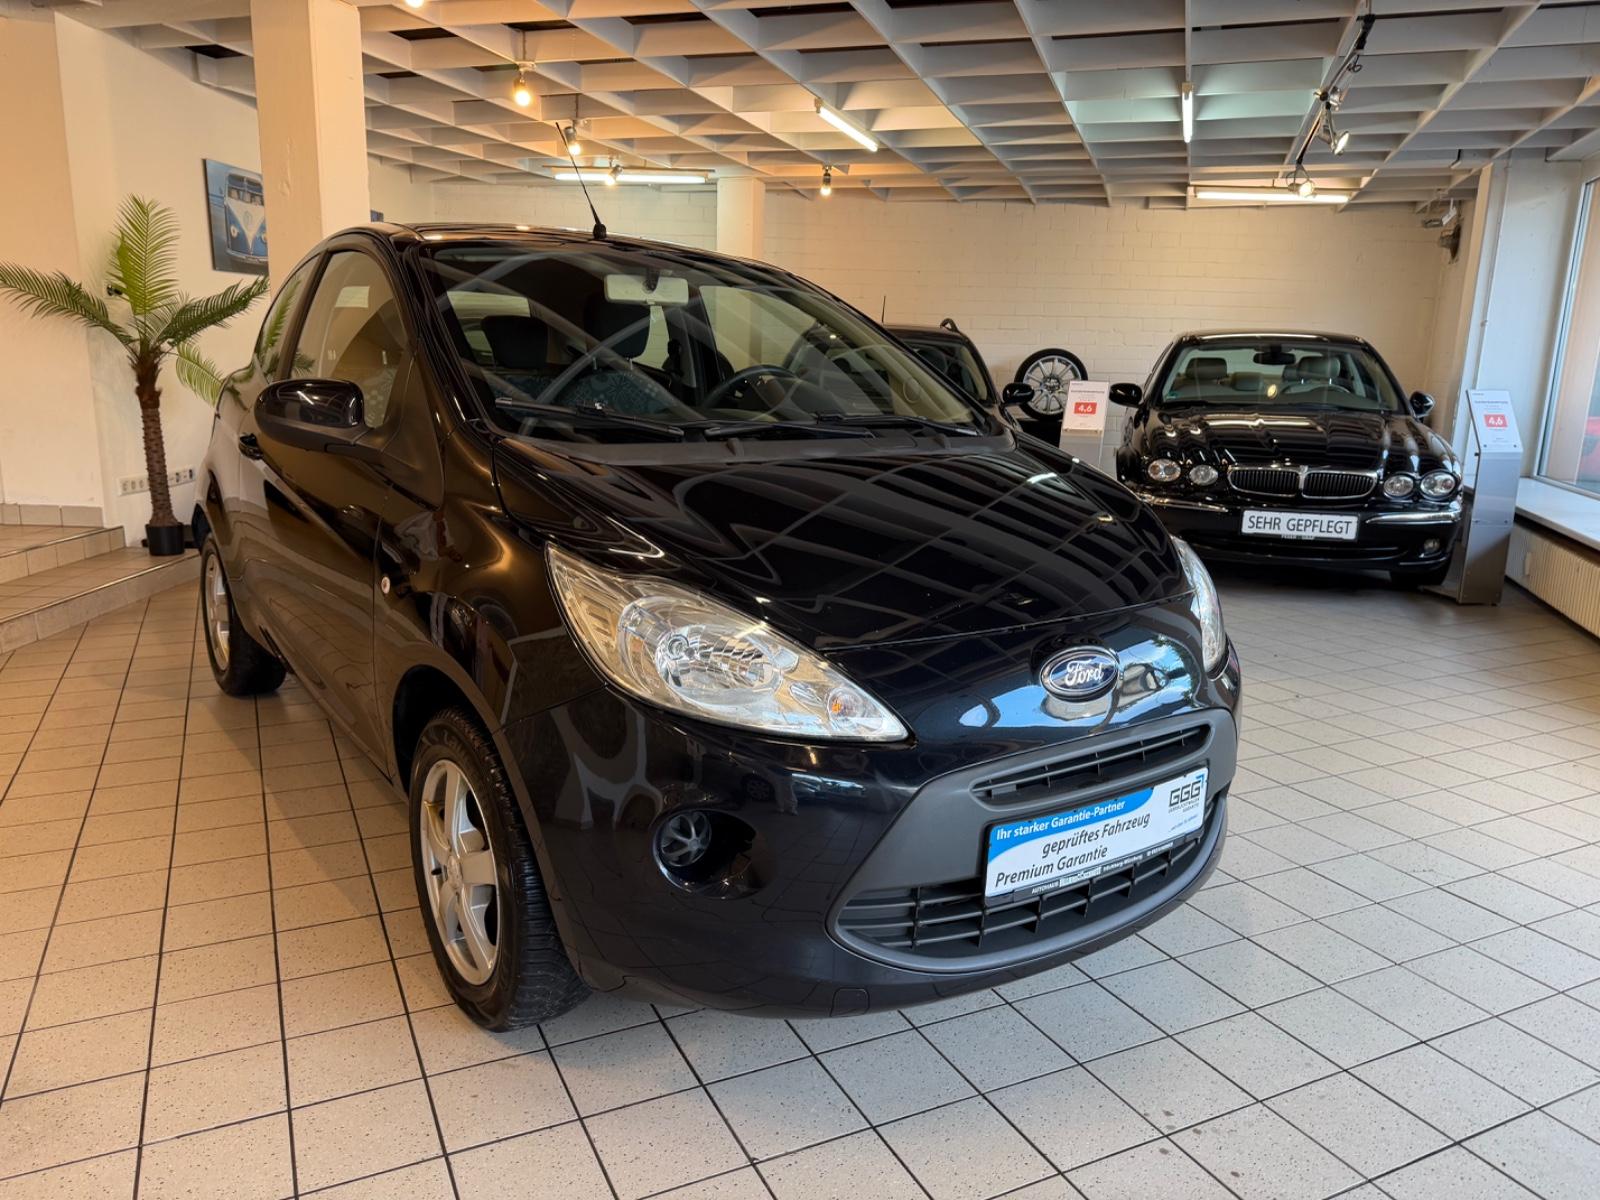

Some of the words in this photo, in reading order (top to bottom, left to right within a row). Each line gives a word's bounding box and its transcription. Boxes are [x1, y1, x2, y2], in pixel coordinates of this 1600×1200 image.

[1247, 514, 1282, 531] SEHR
[1286, 517, 1353, 535] GEPFLEGT
[1065, 659, 1104, 687] Ford
[1169, 780, 1201, 807] GGG
[996, 828, 1012, 841] Ihr
[1014, 821, 1050, 837] starker
[1051, 800, 1126, 828] Garantie-Partner
[1042, 829, 1100, 859] geprüftes
[1101, 813, 1151, 838] Fahrzeug
[995, 861, 1054, 888] Premium
[1056, 845, 1108, 871] Garantie
